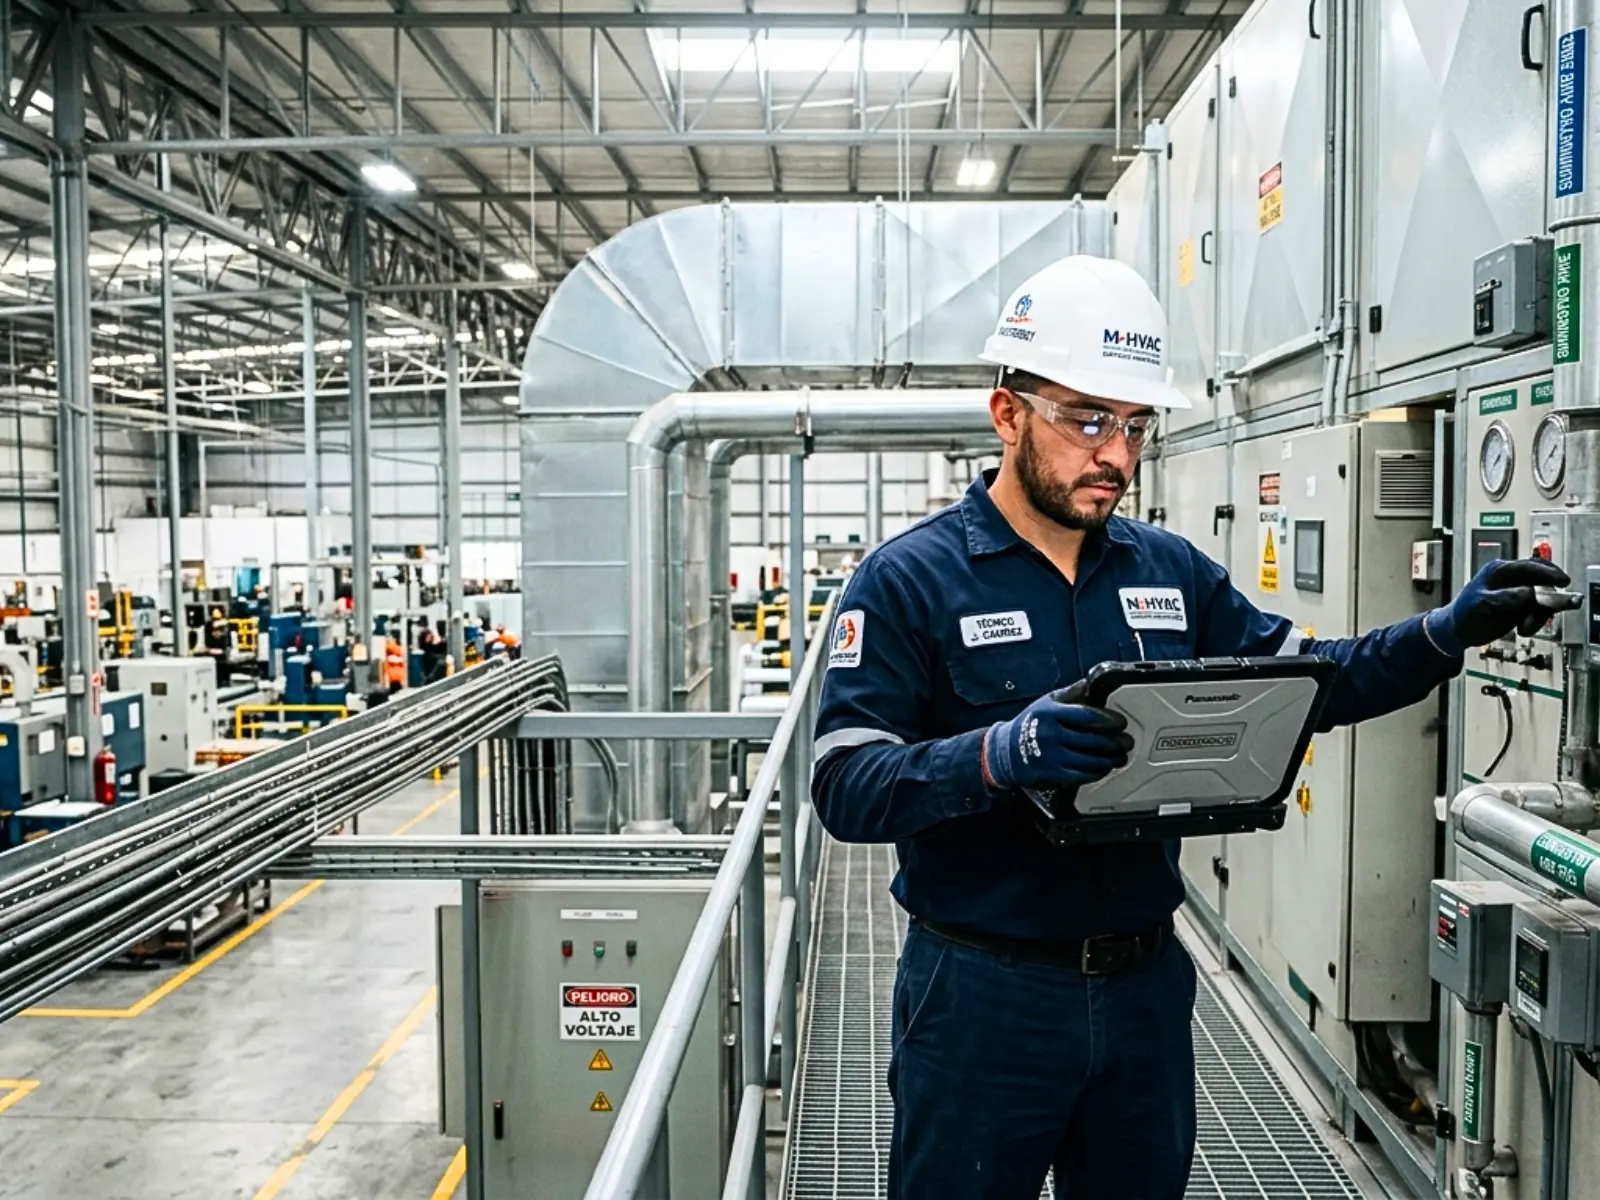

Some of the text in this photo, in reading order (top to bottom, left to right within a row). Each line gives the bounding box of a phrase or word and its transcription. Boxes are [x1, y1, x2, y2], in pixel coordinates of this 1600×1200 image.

[1104, 329, 1161, 352] M-HVAC
[571, 992, 629, 1002] PELIGRO
[580, 1011, 621, 1022] ALTO
[565, 1025, 635, 1036] VOLTAJE
